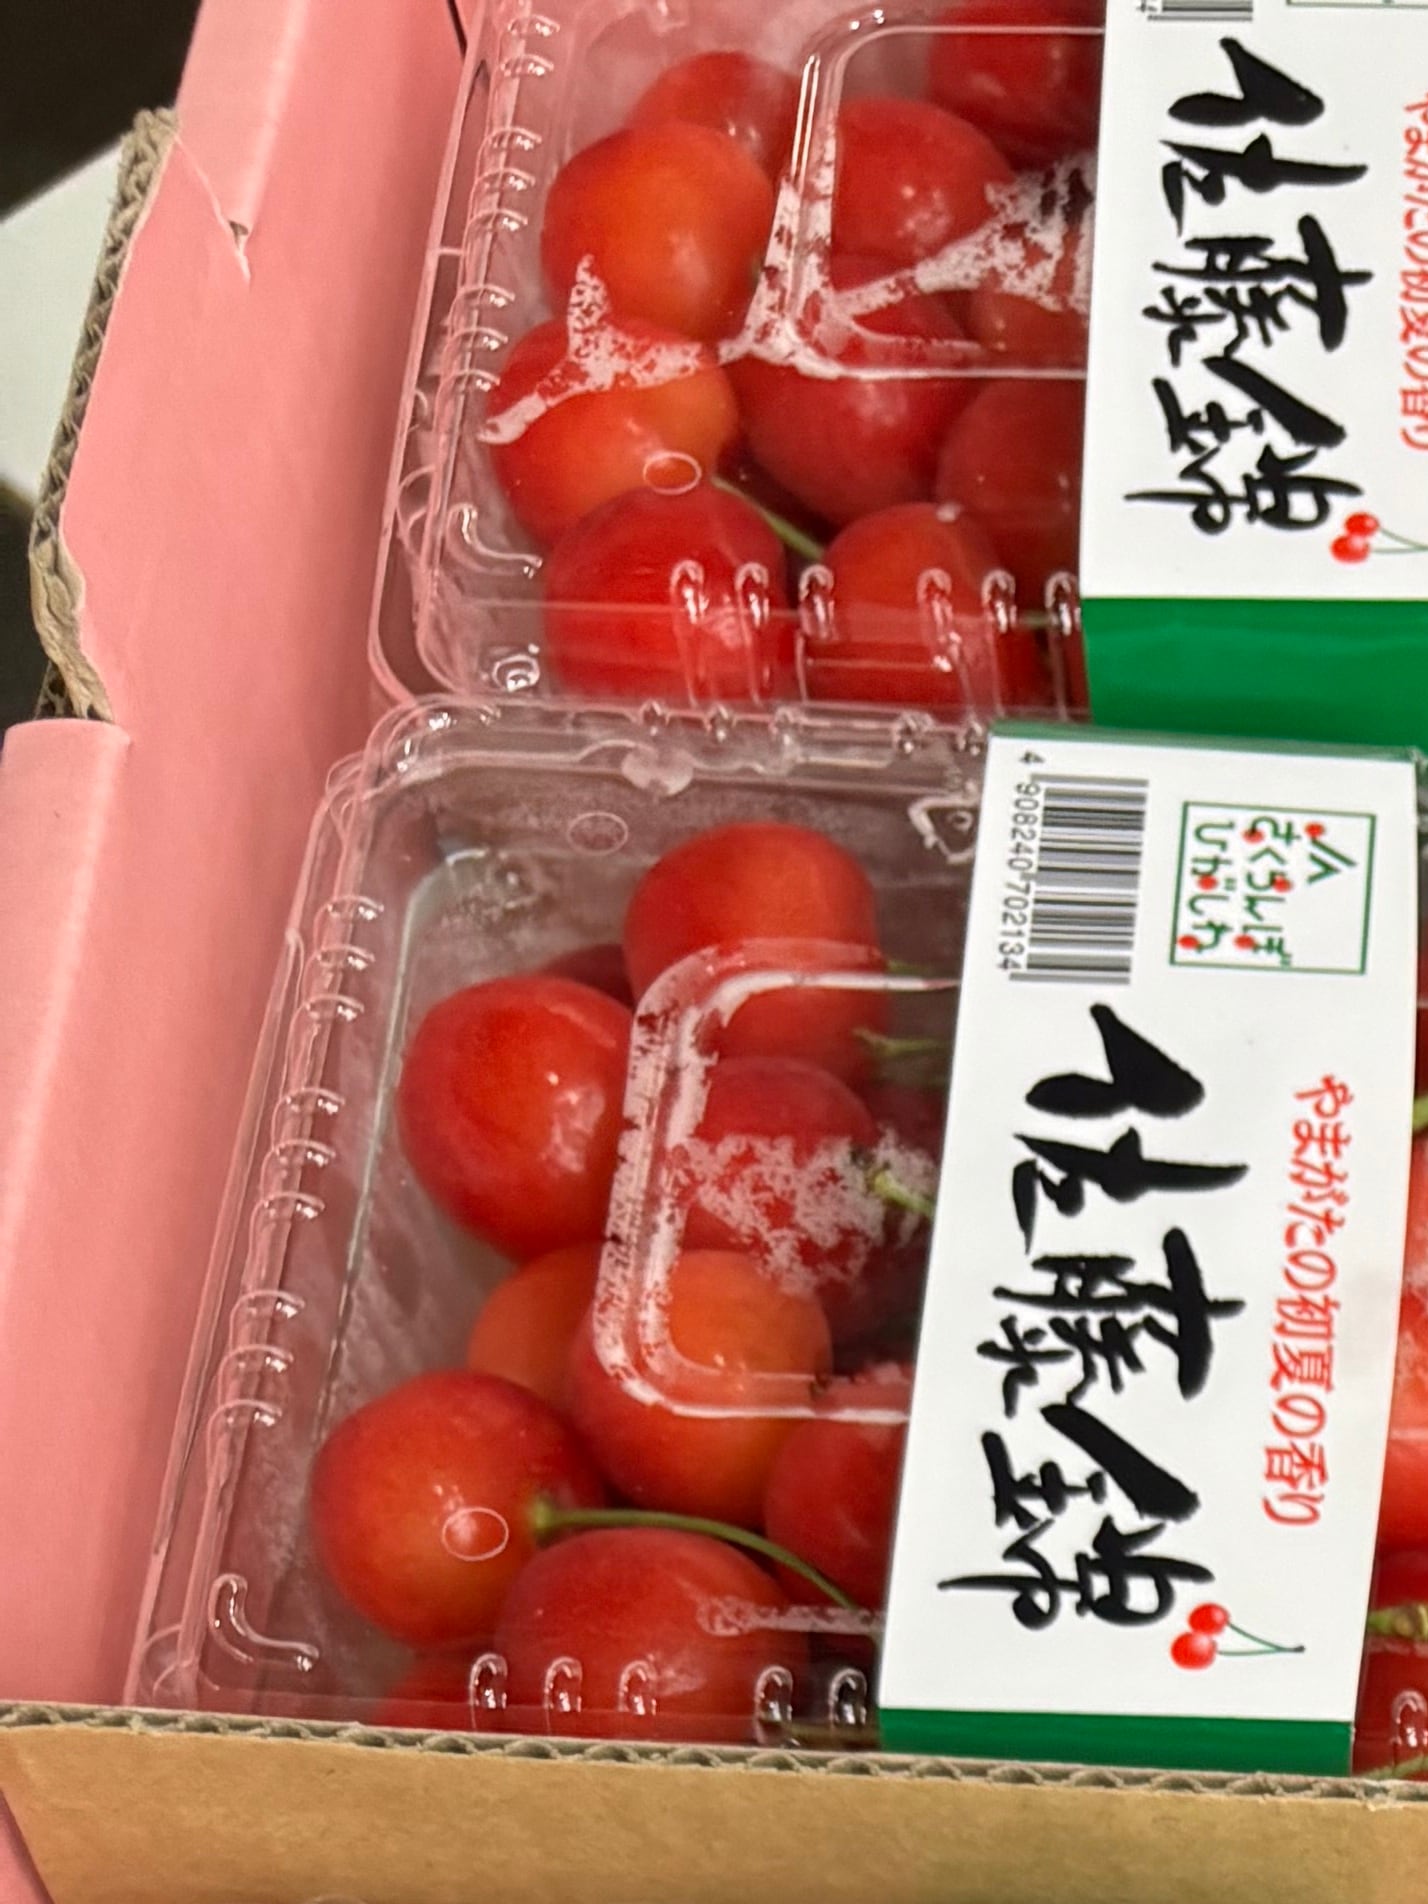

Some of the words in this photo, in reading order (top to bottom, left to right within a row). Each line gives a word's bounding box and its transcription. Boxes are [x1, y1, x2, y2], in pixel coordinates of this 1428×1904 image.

[1126, 38, 1372, 533] 佐藤錦
[1020, 751, 1045, 765] 4
[1234, 816, 1302, 967] さくらんぼ
[938, 1004, 1246, 1628] 佐藤錦
[1261, 1074, 1354, 1526] やまがたの初夏の香り
